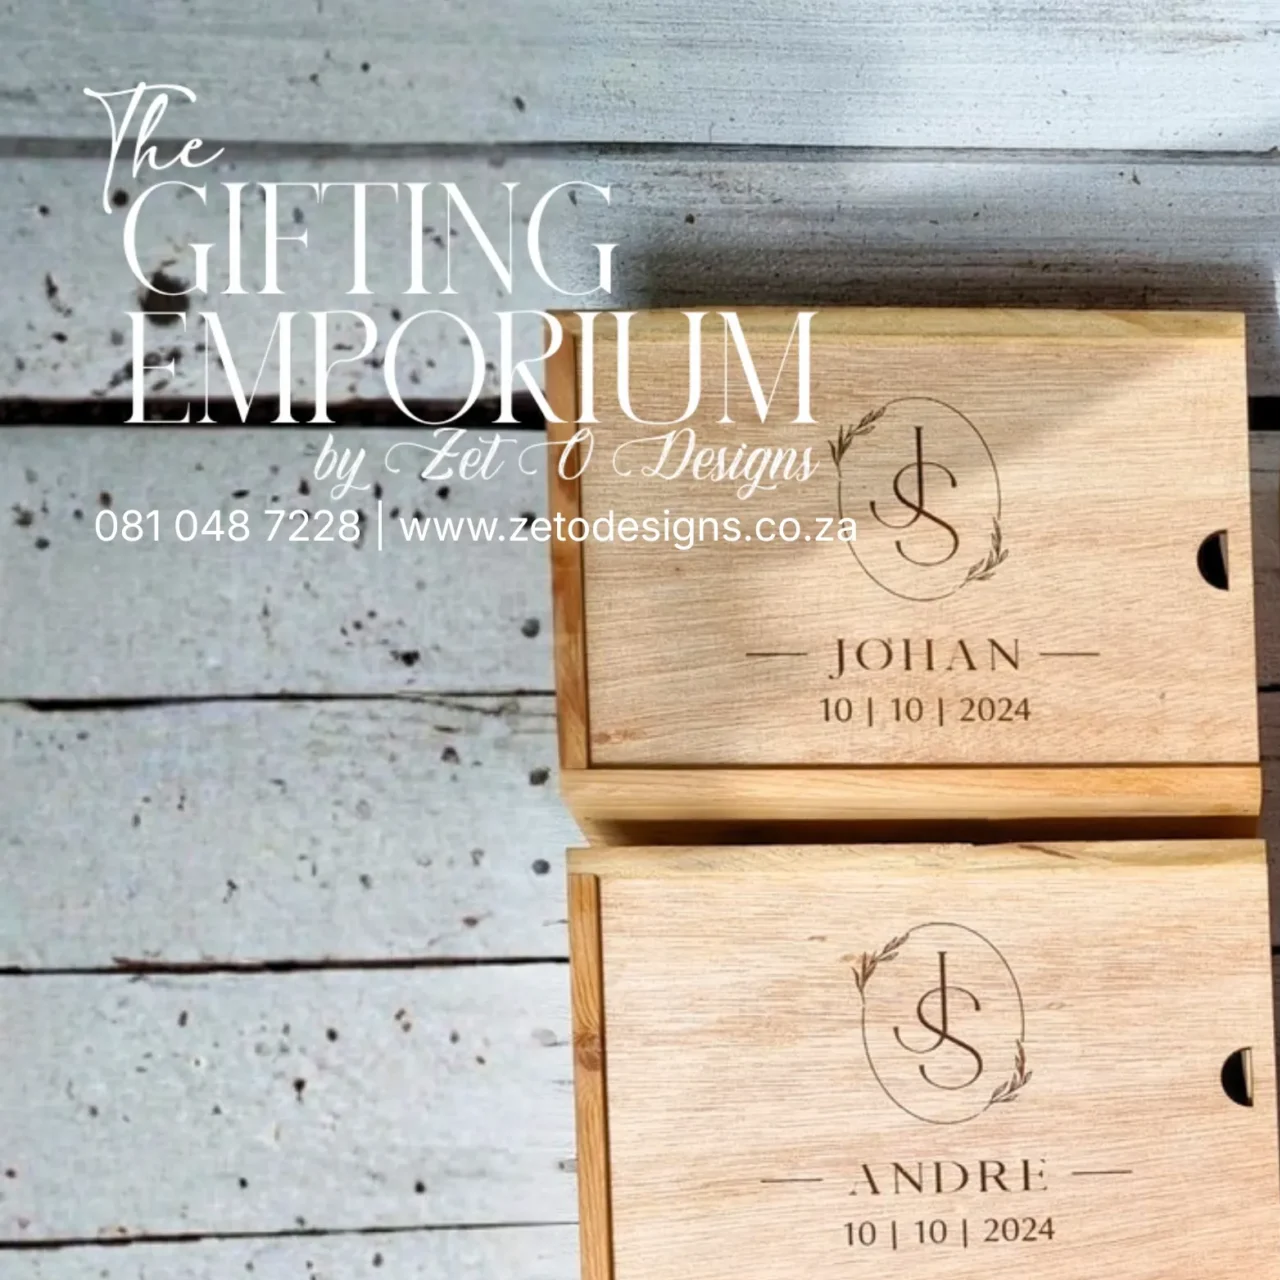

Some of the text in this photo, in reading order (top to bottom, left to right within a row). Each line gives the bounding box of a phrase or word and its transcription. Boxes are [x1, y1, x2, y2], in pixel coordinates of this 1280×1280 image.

[827, 637, 1022, 681] JOHAN
[819, 697, 853, 723] 10
[890, 696, 924, 723] 10
[959, 696, 1032, 723] 2024
[848, 1157, 1049, 1197] ANDRE
[843, 1220, 877, 1247] 10
[914, 1218, 948, 1245] 10
[983, 1216, 1056, 1243] 2024
